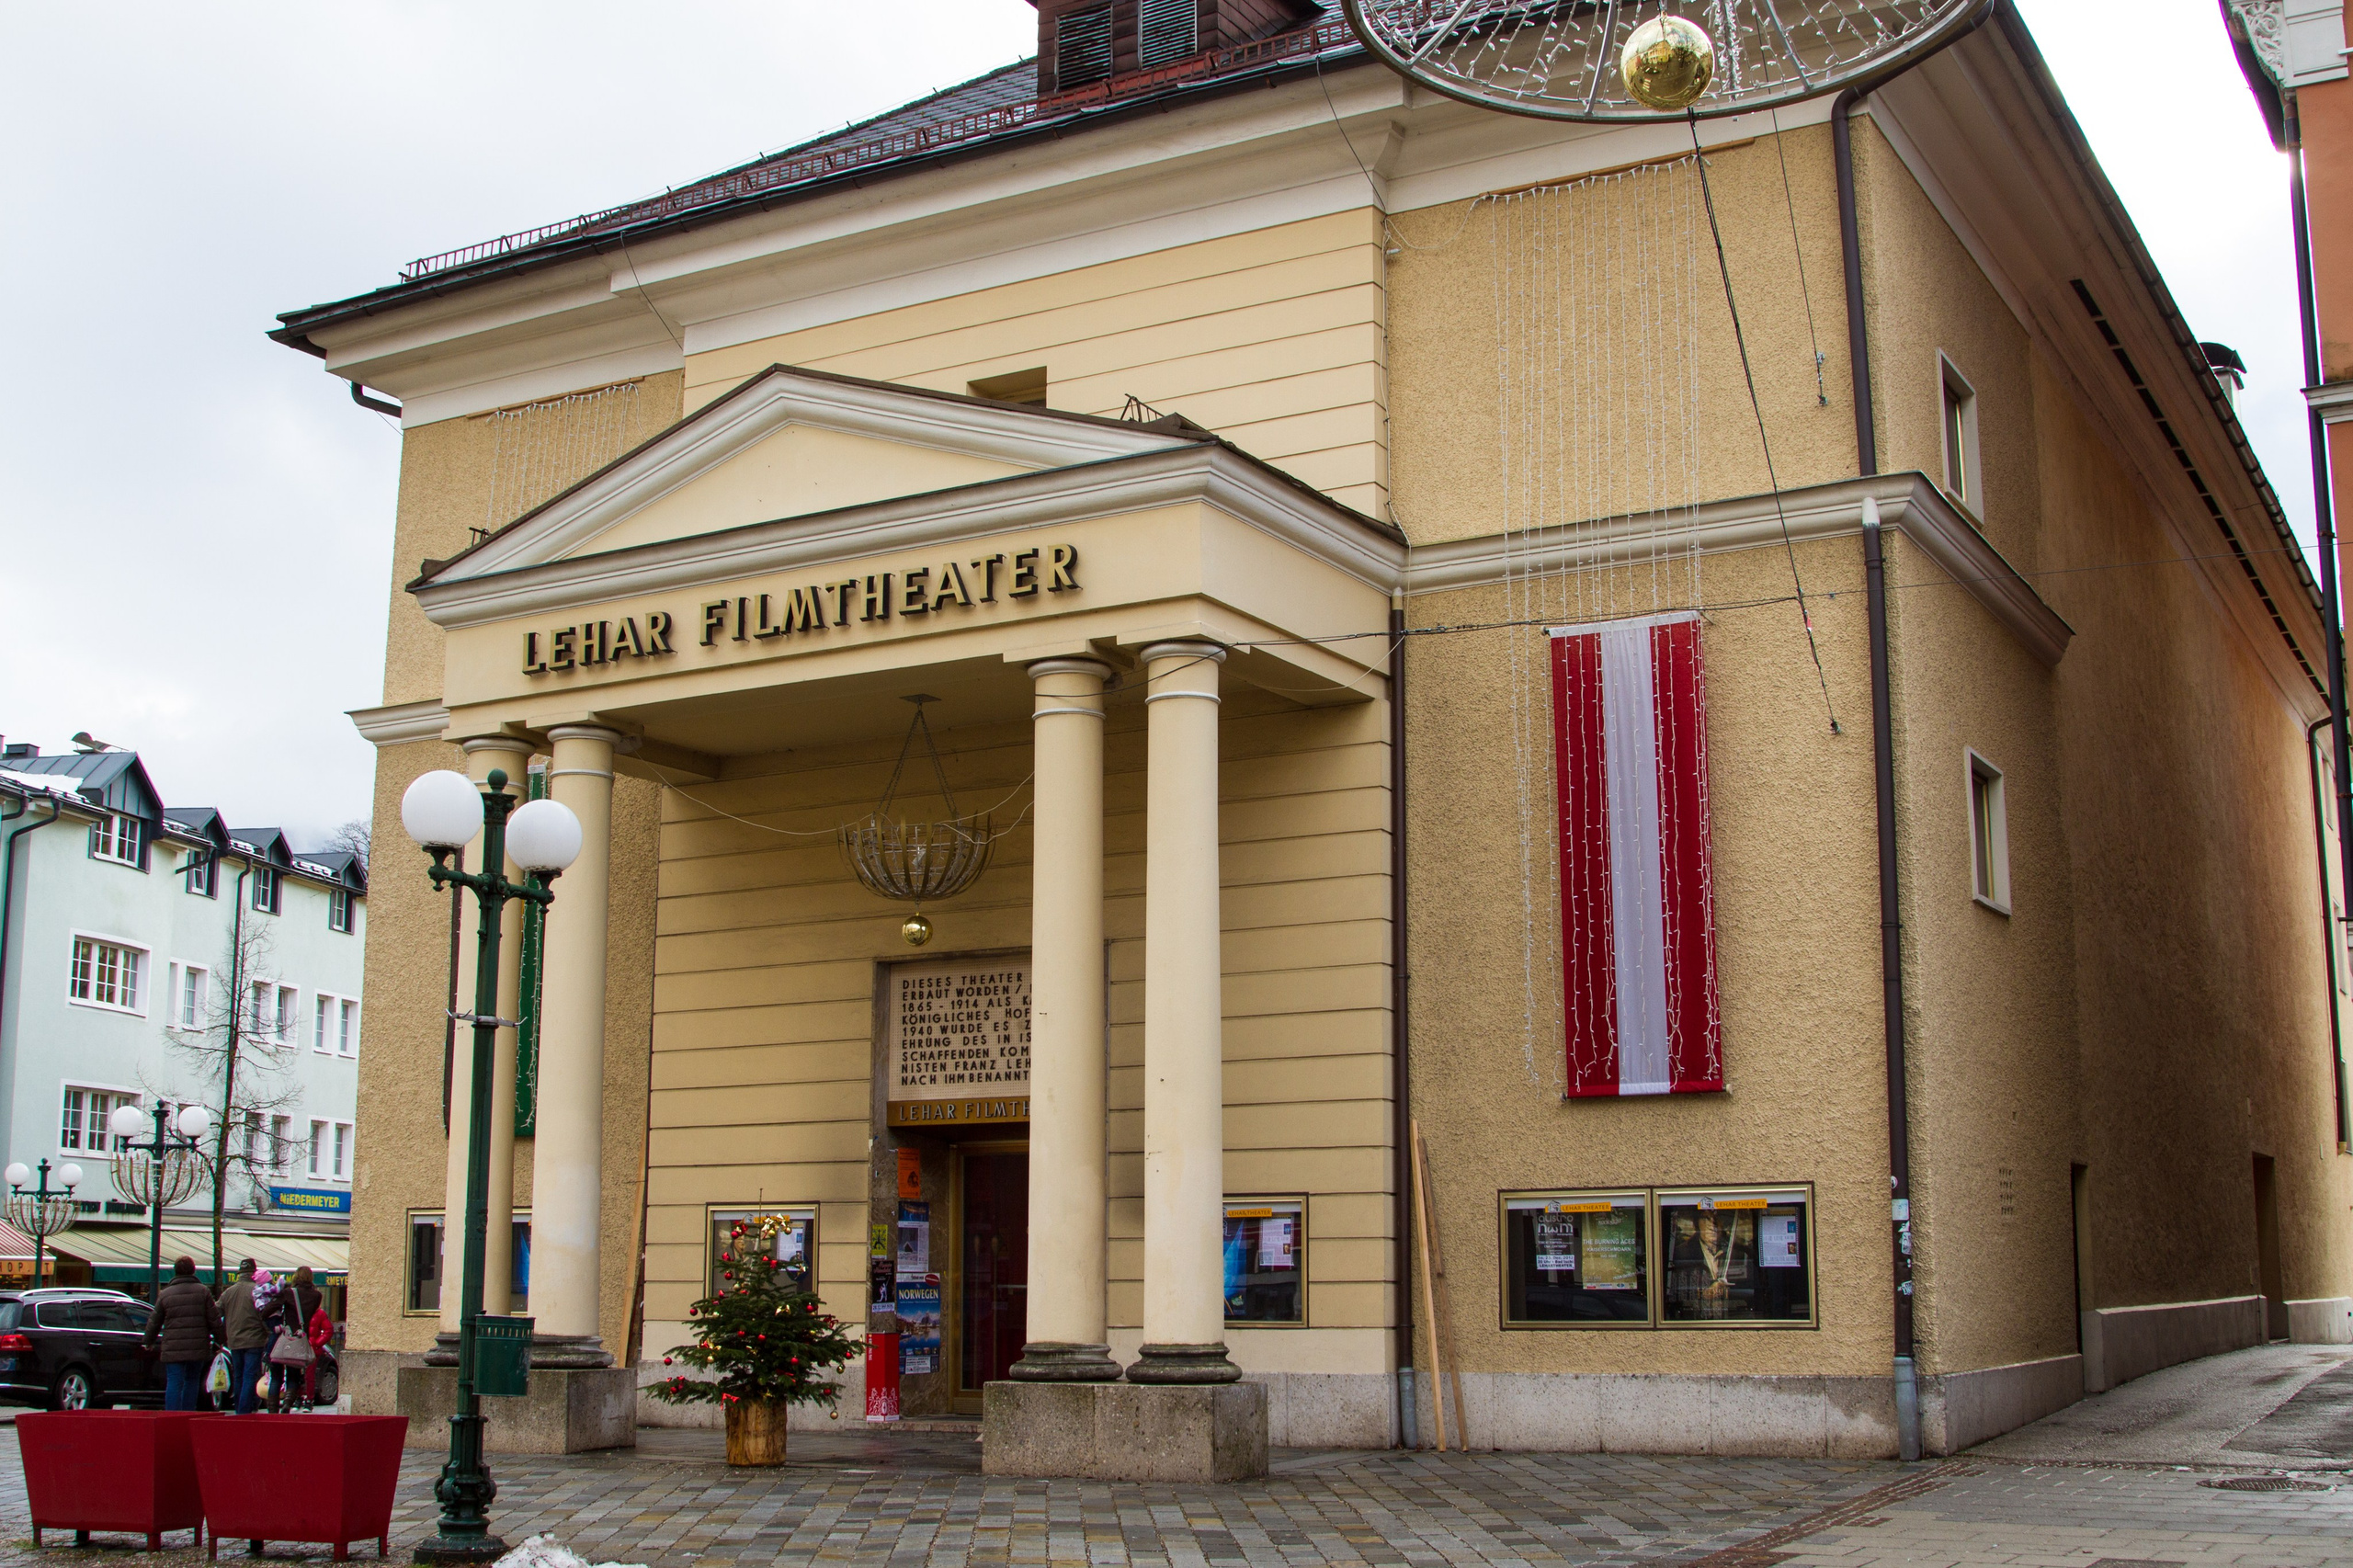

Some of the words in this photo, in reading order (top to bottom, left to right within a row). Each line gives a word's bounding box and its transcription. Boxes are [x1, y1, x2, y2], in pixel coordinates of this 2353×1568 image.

[521, 610, 677, 676] LEHAR
[699, 542, 1084, 647] FILMTHEATER
[903, 977, 951, 989] DIESES
[961, 972, 1022, 985] THEATER
[903, 989, 949, 1001] ERBAUT
[956, 984, 1009, 997] WORDEN
[903, 1001, 932, 1013] 1865
[950, 999, 979, 1009] 1914
[987, 996, 1011, 1008] ALS
[903, 1010, 990, 1025] KÖNIGLICHES
[903, 1026, 932, 1037] 1940
[939, 1023, 983, 1035] WURDE
[994, 1021, 1009, 1032] ES
[903, 1037, 951, 1050] EHRUNG
[963, 1034, 987, 1046] DES
[997, 1034, 1010, 1044] IN
[903, 1048, 990, 1062] SCHAFFENDEN
[902, 1062, 947, 1074] NISTEN
[955, 1060, 996, 1072] FRANZ
[902, 1074, 937, 1085] NACH
[945, 1074, 965, 1084] IHM
[970, 1070, 1029, 1083] BENANNT
[899, 1104, 958, 1121] LEHAR
[1738, 1199, 1767, 1208] THEATER
[898, 1289, 939, 1300] NORWEGEN
